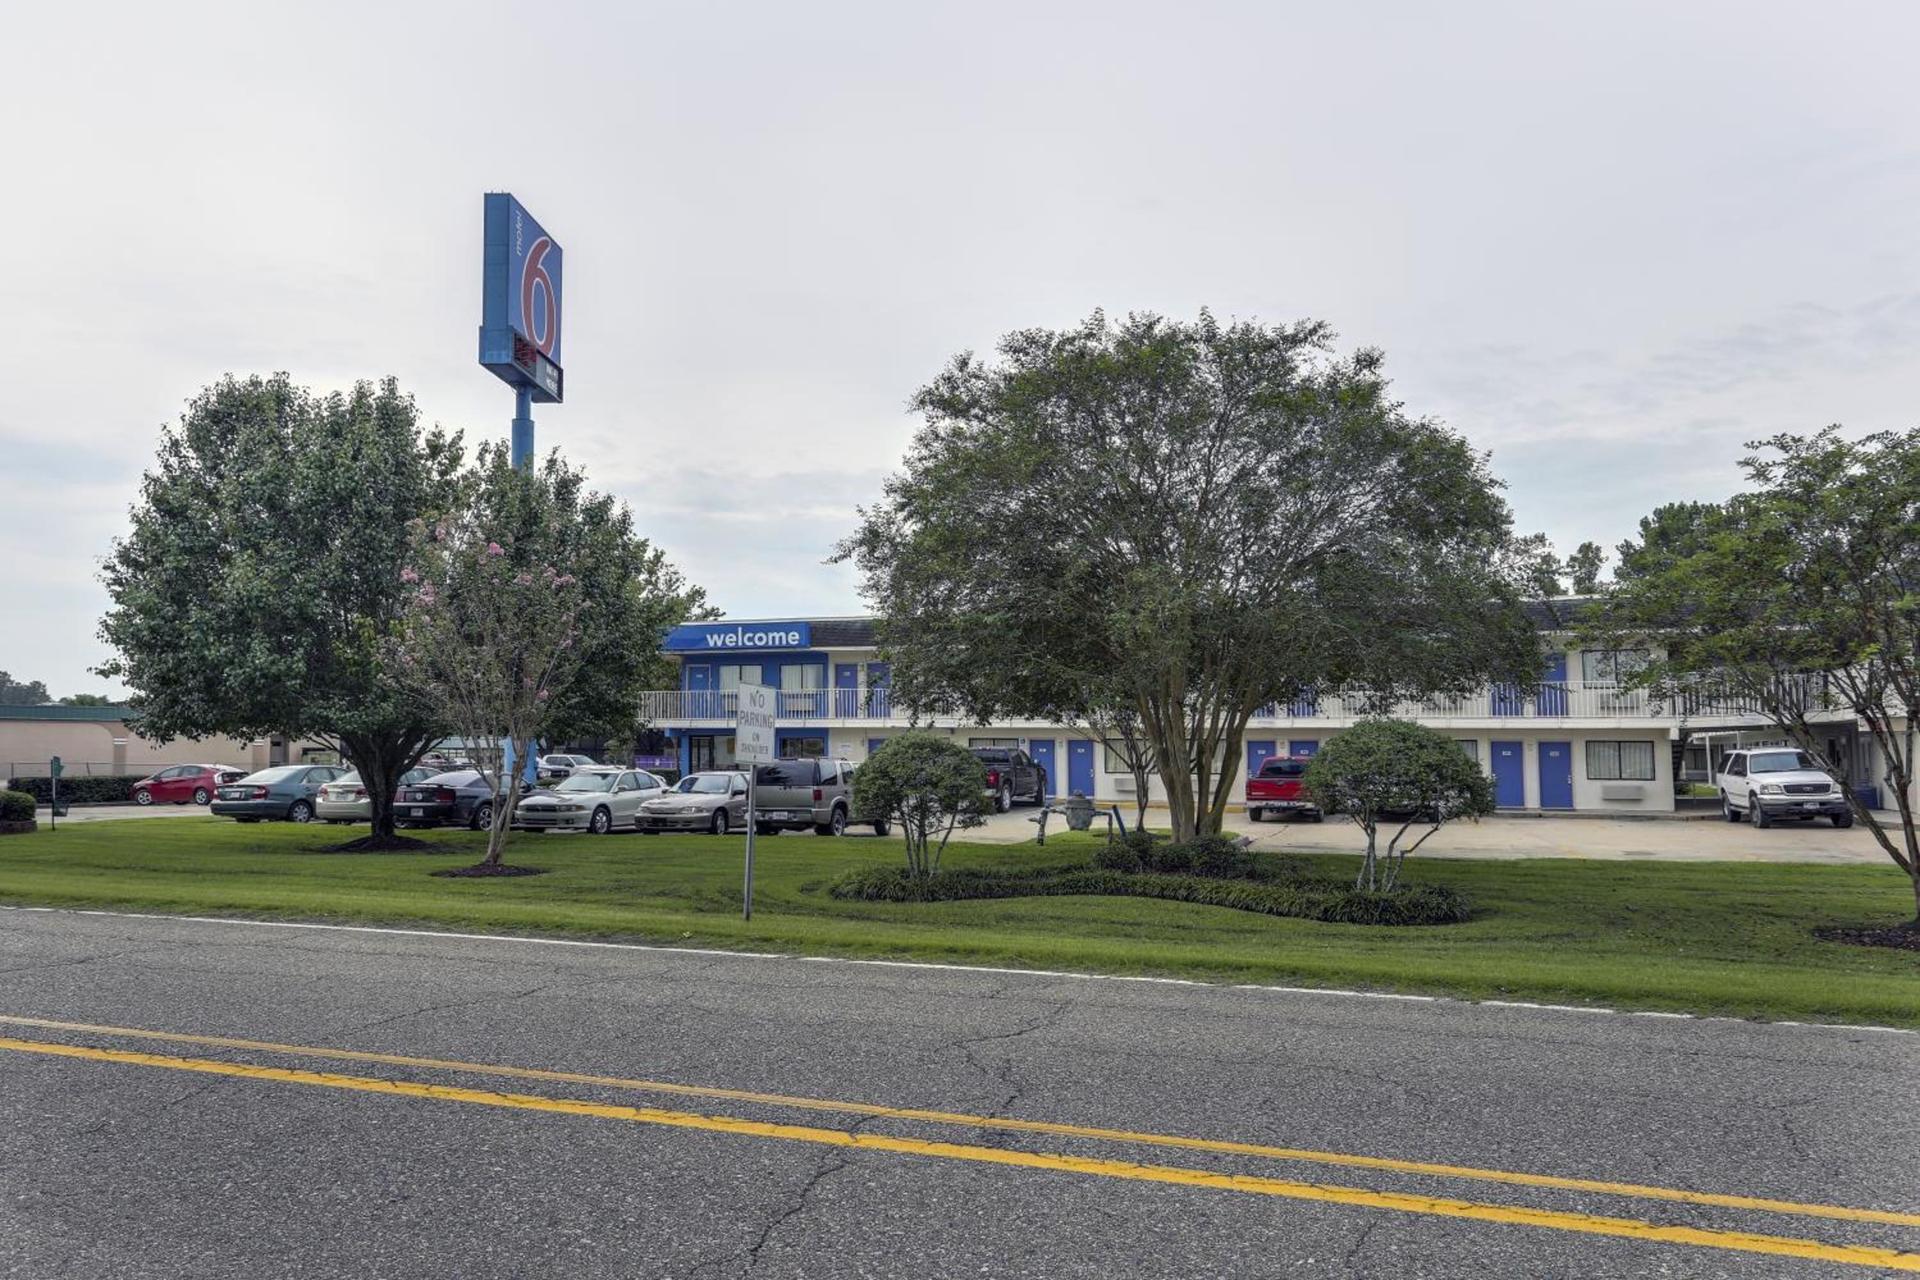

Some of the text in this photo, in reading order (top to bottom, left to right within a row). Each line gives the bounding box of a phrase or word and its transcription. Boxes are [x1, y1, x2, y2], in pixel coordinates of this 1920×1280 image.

[515, 210, 523, 257] motel
[521, 236, 556, 357] 6
[706, 627, 800, 647] welcome
[749, 692, 765, 709] NO
[740, 710, 773, 729] PARKING
